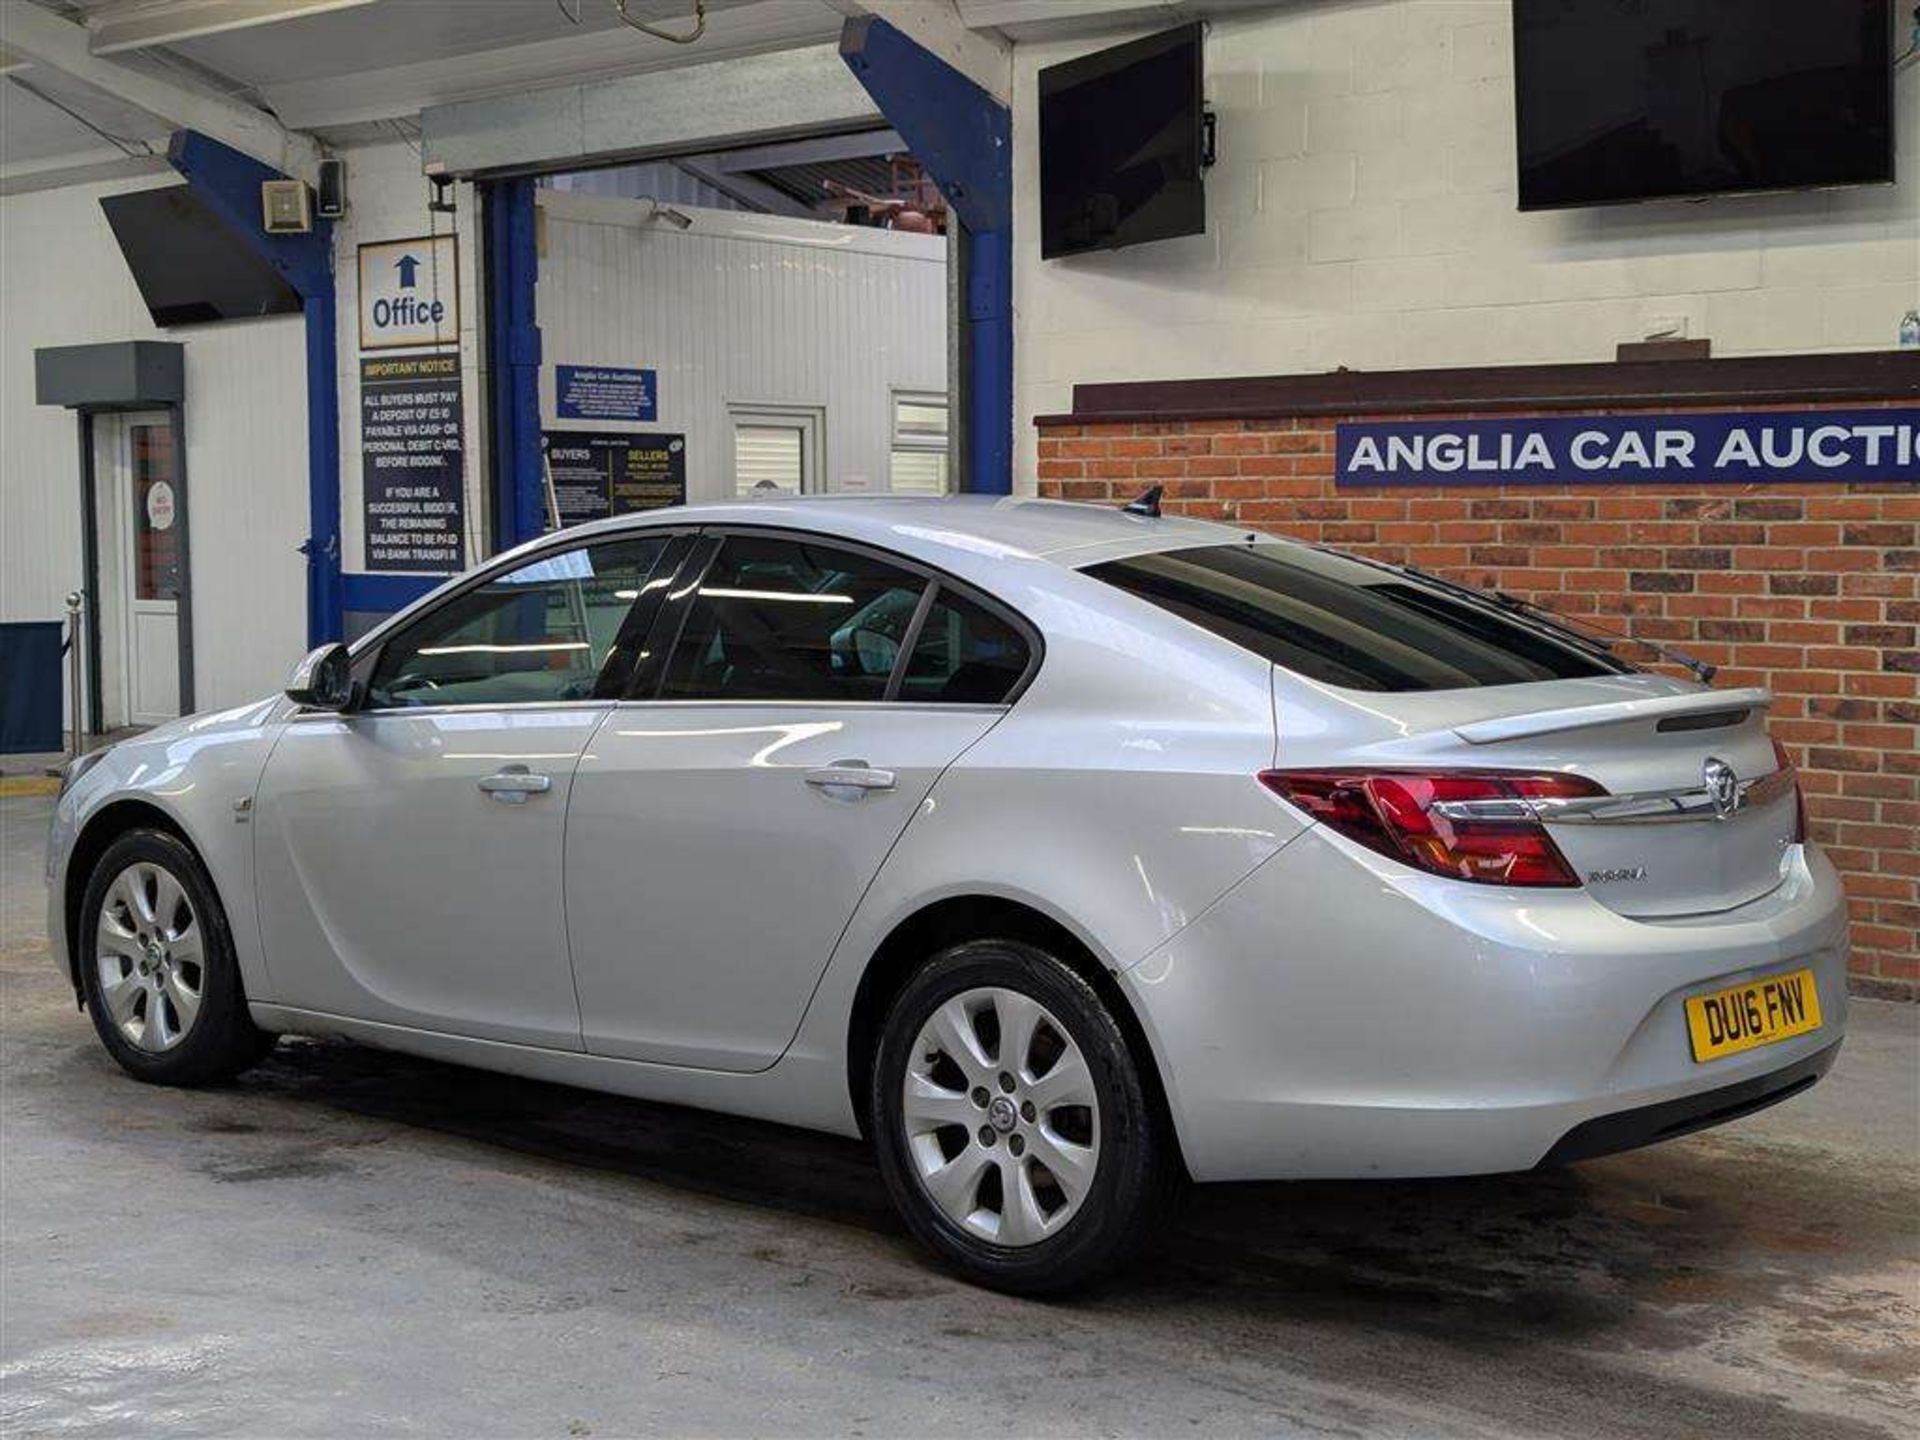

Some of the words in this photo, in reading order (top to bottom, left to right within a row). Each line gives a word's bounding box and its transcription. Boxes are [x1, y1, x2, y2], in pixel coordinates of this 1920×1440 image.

[374, 298, 444, 327] Office
[365, 363, 417, 376] IMPORTANT
[420, 360, 455, 372] NOTICE
[364, 395, 379, 406] ALL
[381, 393, 413, 405] BUYERS
[415, 392, 438, 404] MUST
[372, 411, 379, 420] A
[381, 409, 414, 421] DEPOSIT
[416, 409, 426, 419] OF
[365, 425, 402, 437] PAYABLE
[404, 425, 417, 435] VIA
[443, 422, 458, 434] OR
[363, 440, 405, 453] PERSONAL
[407, 439, 433, 451] DEBIT
[1348, 433, 1555, 472] ANGLIA
[1570, 430, 1695, 470] CAR
[1714, 425, 1920, 467] AUCTI
[552, 449, 591, 460] BUYERS
[375, 456, 408, 468] BEFORE
[410, 455, 448, 467] BIDDIN.
[385, 487, 393, 498] IF
[395, 487, 413, 498] YOU
[414, 487, 431, 498] ARE
[432, 487, 440, 498] A
[368, 502, 422, 514] SUCCESSFUL
[381, 518, 397, 530] THE
[399, 518, 447, 530] REMAINING
[371, 533, 409, 545] BALANCE
[411, 533, 422, 544] TO
[424, 533, 436, 544] BE
[372, 549, 387, 560] VIA
[387, 549, 411, 560] BANK
[1703, 990, 1763, 1047] DU16
[1763, 976, 1806, 1031] FNV
